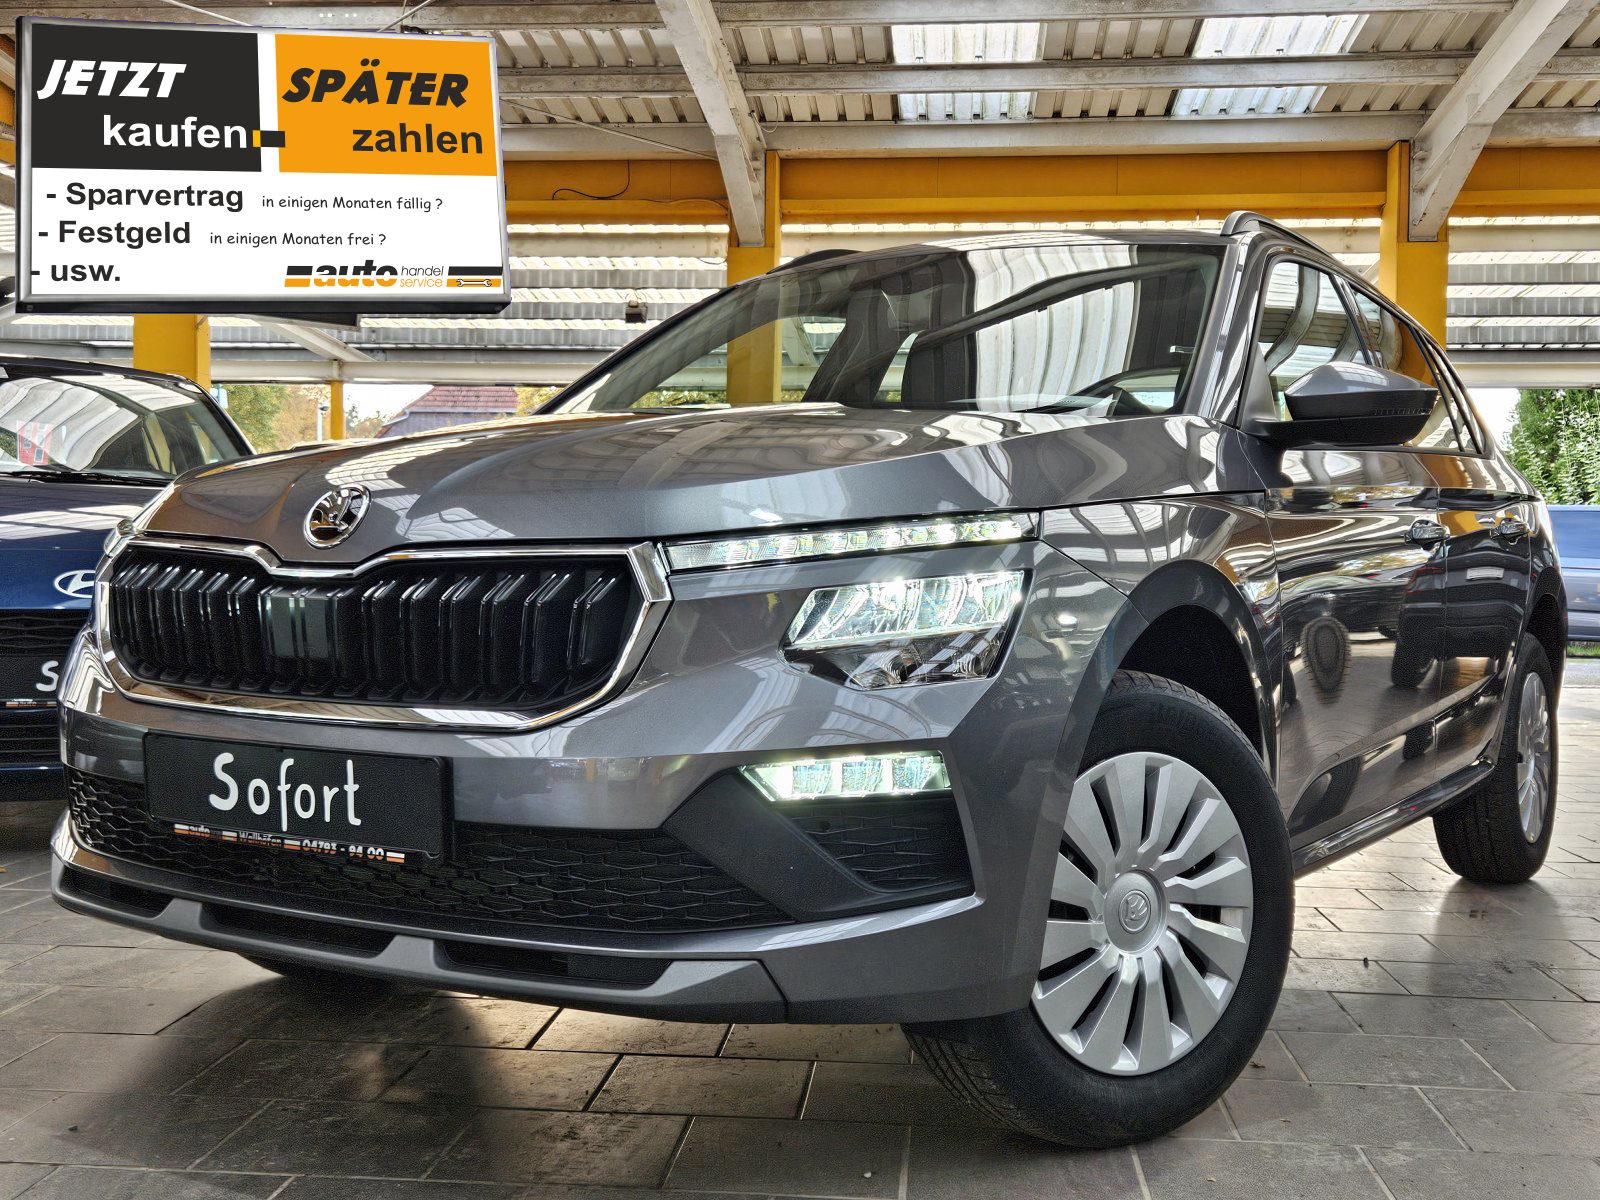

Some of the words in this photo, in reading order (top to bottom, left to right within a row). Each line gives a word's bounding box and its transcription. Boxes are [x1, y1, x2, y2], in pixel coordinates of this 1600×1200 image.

[36, 59, 187, 100] JETZT
[281, 58, 469, 108] SPÄTER
[103, 114, 248, 149] kaufen
[352, 122, 483, 154] zahlen
[66, 182, 243, 213] Sparvertrag
[262, 196, 274, 208] in
[278, 196, 328, 212] einigen
[332, 196, 392, 209] Monaten
[396, 196, 431, 213] fällig
[435, 198, 443, 210] ?
[59, 220, 190, 249] Festgeld
[210, 232, 222, 244] in
[226, 232, 277, 248] einigen
[282, 232, 343, 245] Monaten
[347, 232, 374, 246] frei
[378, 233, 387, 245] ?
[51, 264, 121, 282] usw.
[313, 259, 398, 288] auto
[399, 277, 444, 288] service
[400, 265, 445, 277] handel
[208, 751, 362, 833] Sofort
